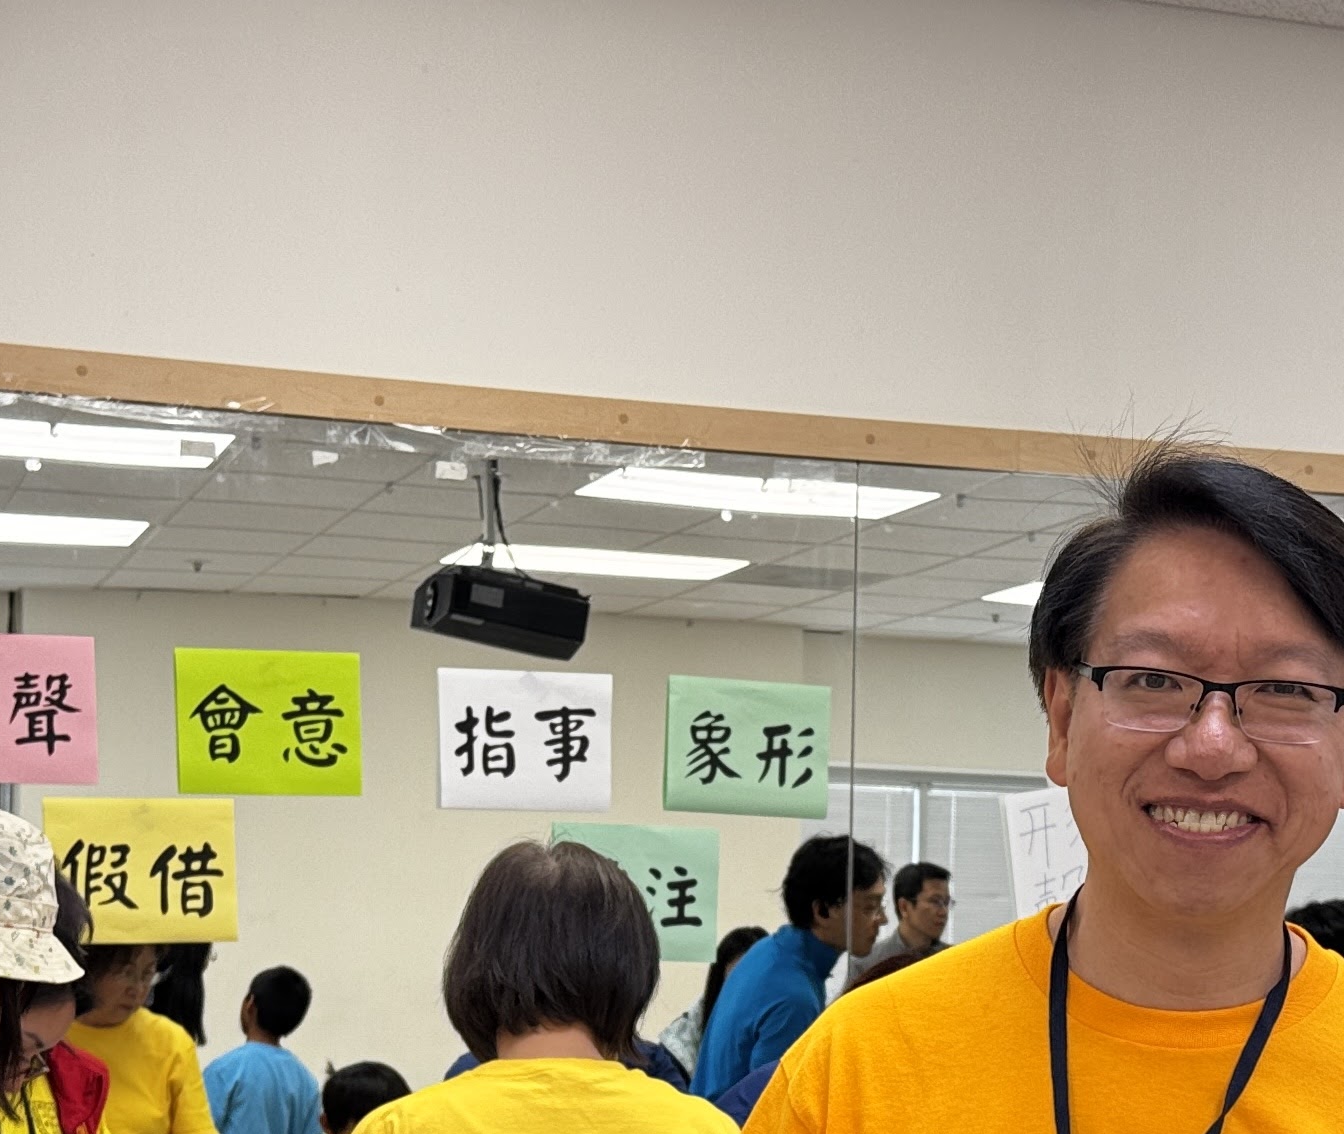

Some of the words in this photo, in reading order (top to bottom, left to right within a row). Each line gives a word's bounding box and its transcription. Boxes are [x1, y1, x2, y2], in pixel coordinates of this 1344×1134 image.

[190, 684, 348, 768] 會意
[454, 706, 596, 782] 指事
[687, 710, 815, 788] 象形
[62, 839, 224, 918] 假借
[1019, 802, 1084, 911] 形
[645, 866, 703, 928] 注
